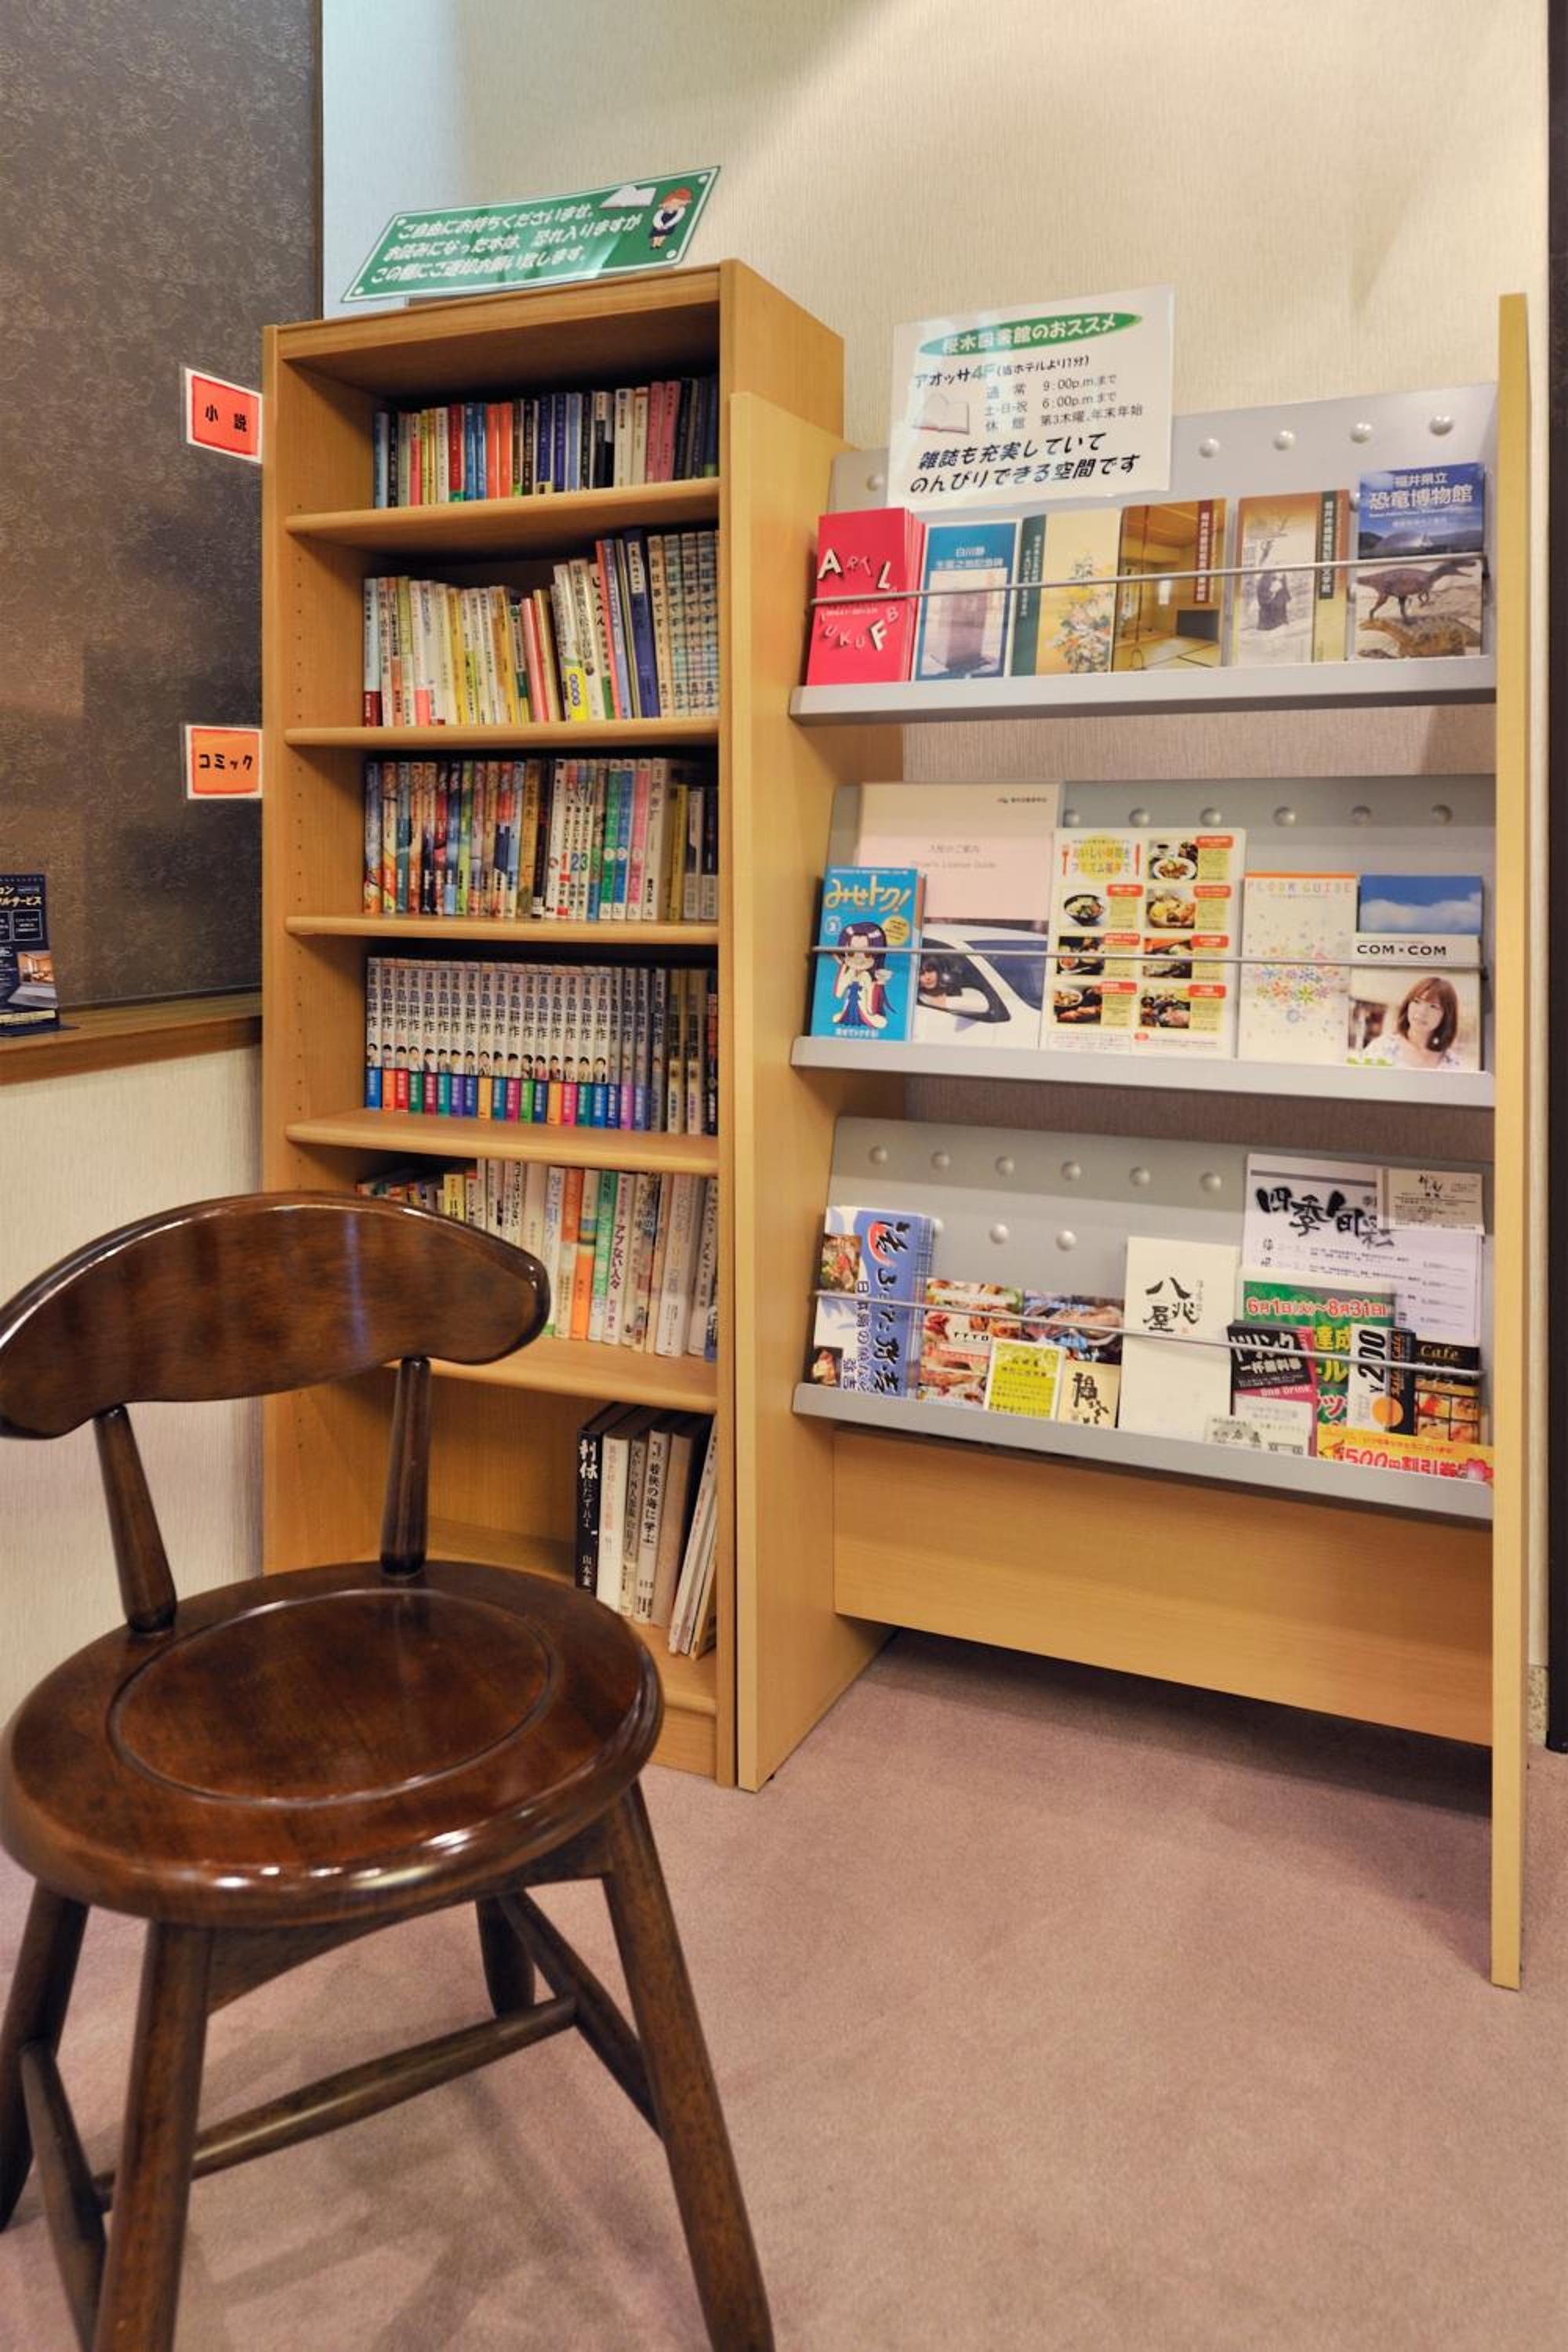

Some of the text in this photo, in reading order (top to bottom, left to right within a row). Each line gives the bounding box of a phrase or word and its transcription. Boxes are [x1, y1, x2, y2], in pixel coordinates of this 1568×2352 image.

[918, 432, 1106, 470] 雑誌も充実していて
[909, 454, 1141, 493] のんびりできる空間です
[199, 753, 252, 771] コミック
